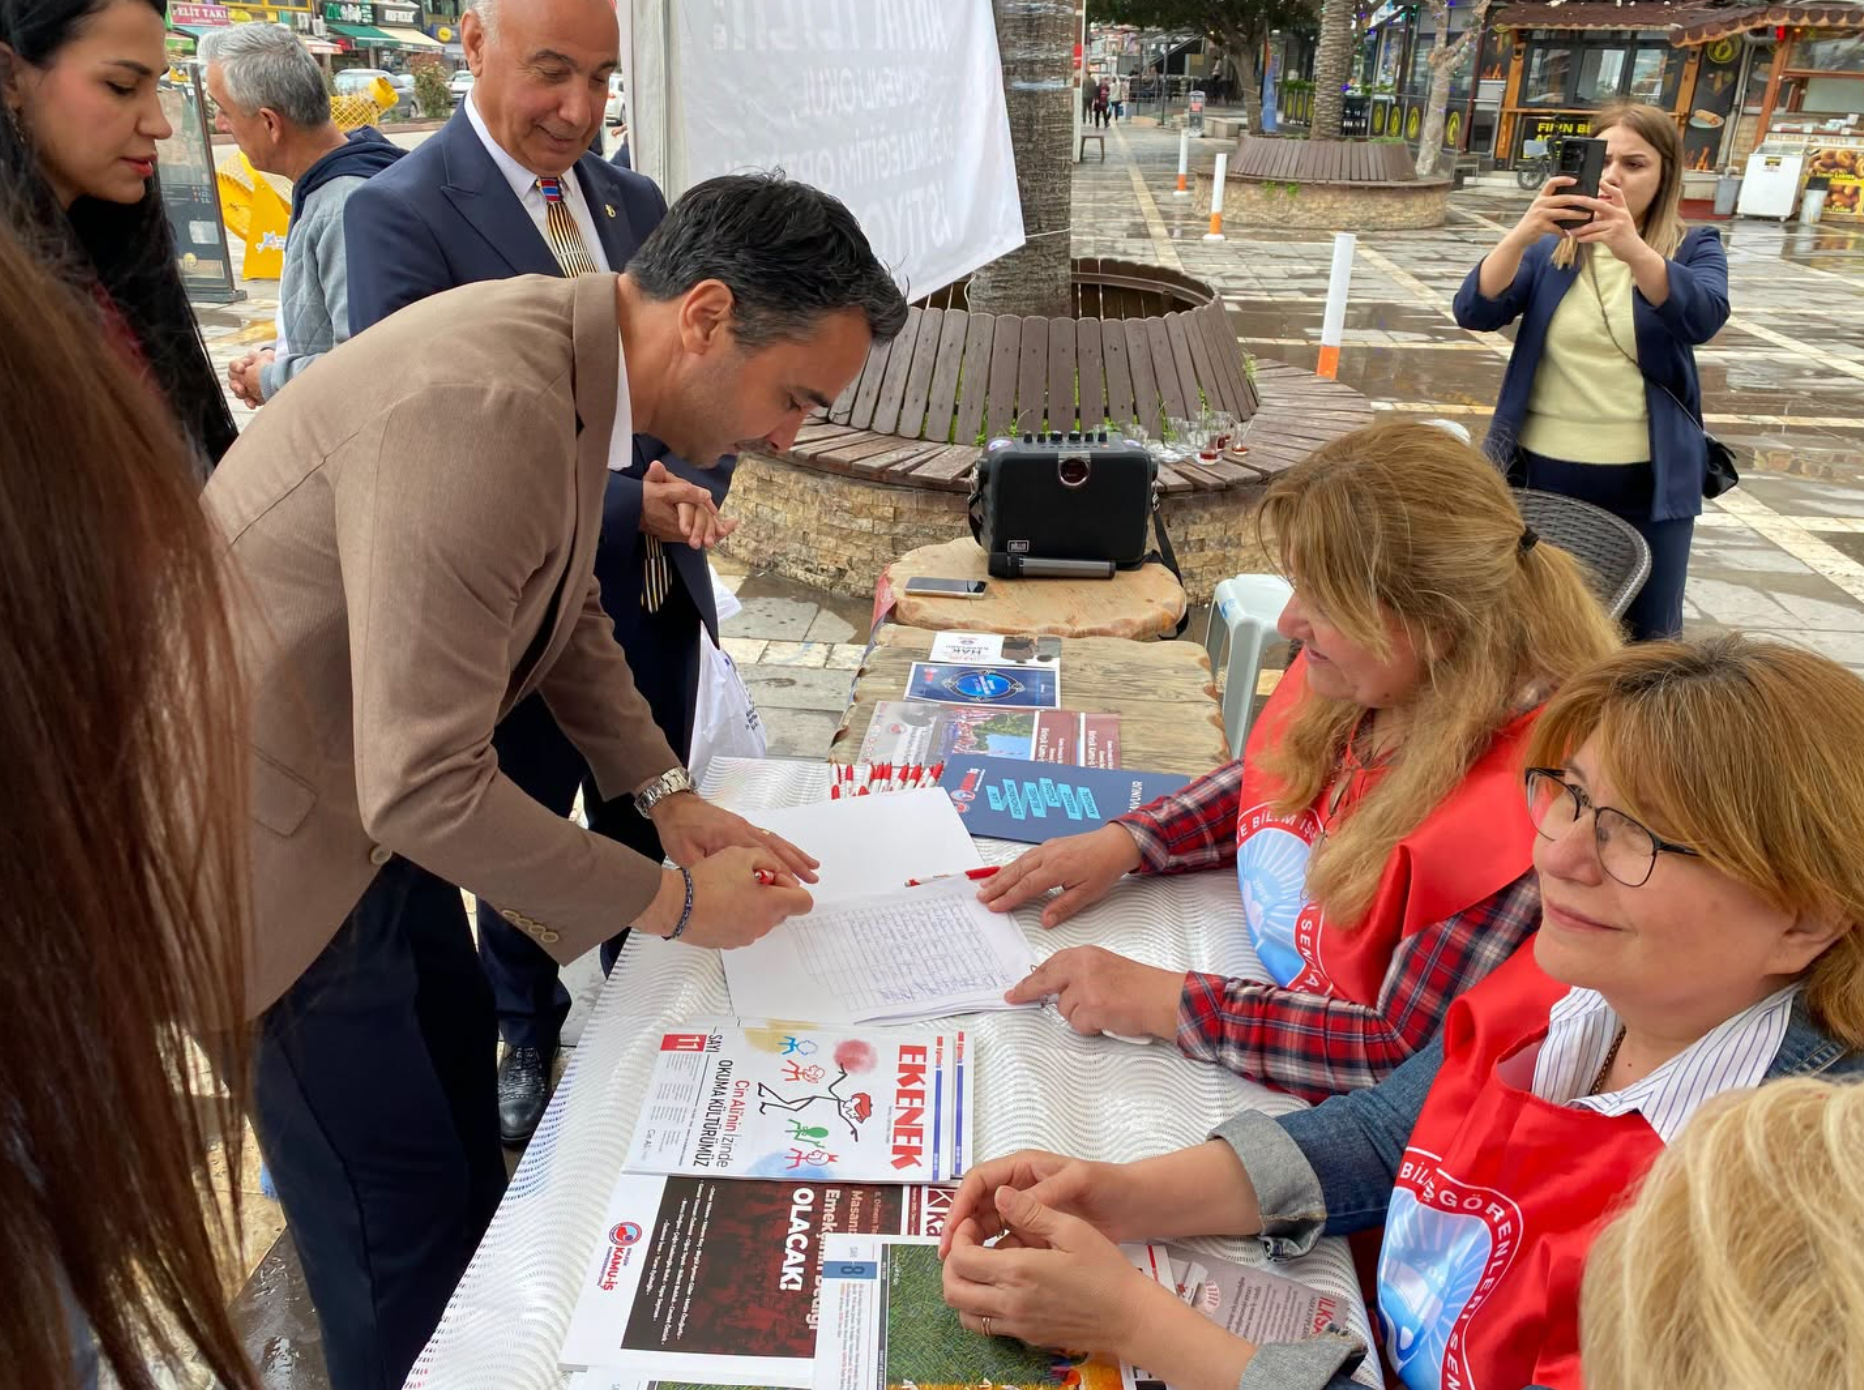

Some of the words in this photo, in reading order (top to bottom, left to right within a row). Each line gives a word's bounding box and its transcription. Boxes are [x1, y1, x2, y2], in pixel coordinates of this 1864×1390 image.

[202, 8, 227, 19] TAKI
[1537, 122, 1574, 133] FIIN
[1128, 780, 1143, 812] AVUNUR
[1252, 810, 1298, 829] BİLM
[676, 1035, 701, 1049] 11
[706, 1034, 723, 1053] SAYI
[711, 1059, 734, 1097] OKUMA
[732, 1080, 750, 1098] Cin
[891, 1045, 927, 1170] EKENEK
[692, 1098, 726, 1167] KÜLTÜRÜMÜZ
[716, 1133, 742, 1168] İzinde
[779, 1187, 815, 1291] OLACAK!
[600, 1247, 625, 1291] KAMU-İŞ
[840, 1265, 865, 1275] 8
